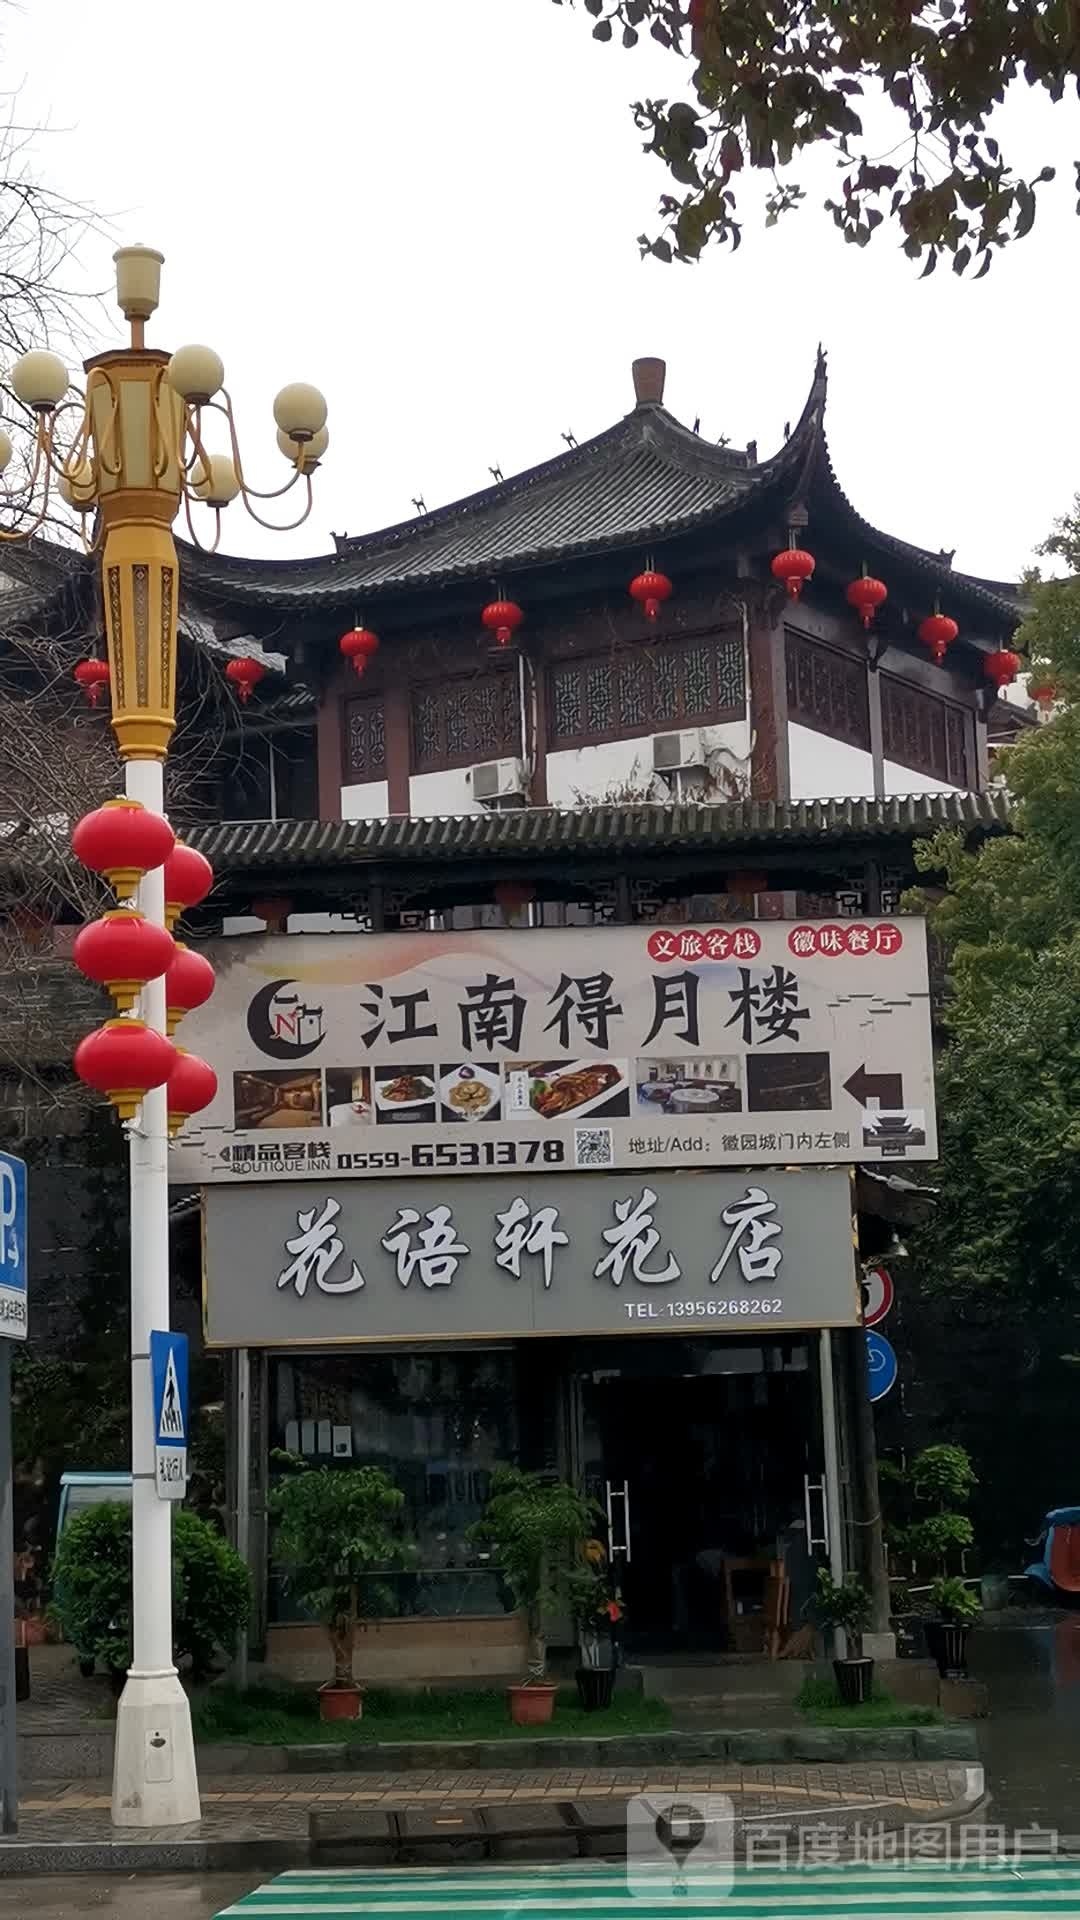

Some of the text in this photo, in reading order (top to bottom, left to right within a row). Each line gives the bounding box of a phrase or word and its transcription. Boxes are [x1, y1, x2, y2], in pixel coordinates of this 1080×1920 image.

[652, 924, 899, 958] 文旅客栈 徽味餐厅
[359, 964, 811, 1053] 江南得月楼
[231, 1141, 331, 1162] 精品客栈
[231, 1157, 331, 1174] BOUTIQUE INN
[337, 1140, 564, 1170] 0559-6531378
[276, 1186, 784, 1297] 花语轩花店
